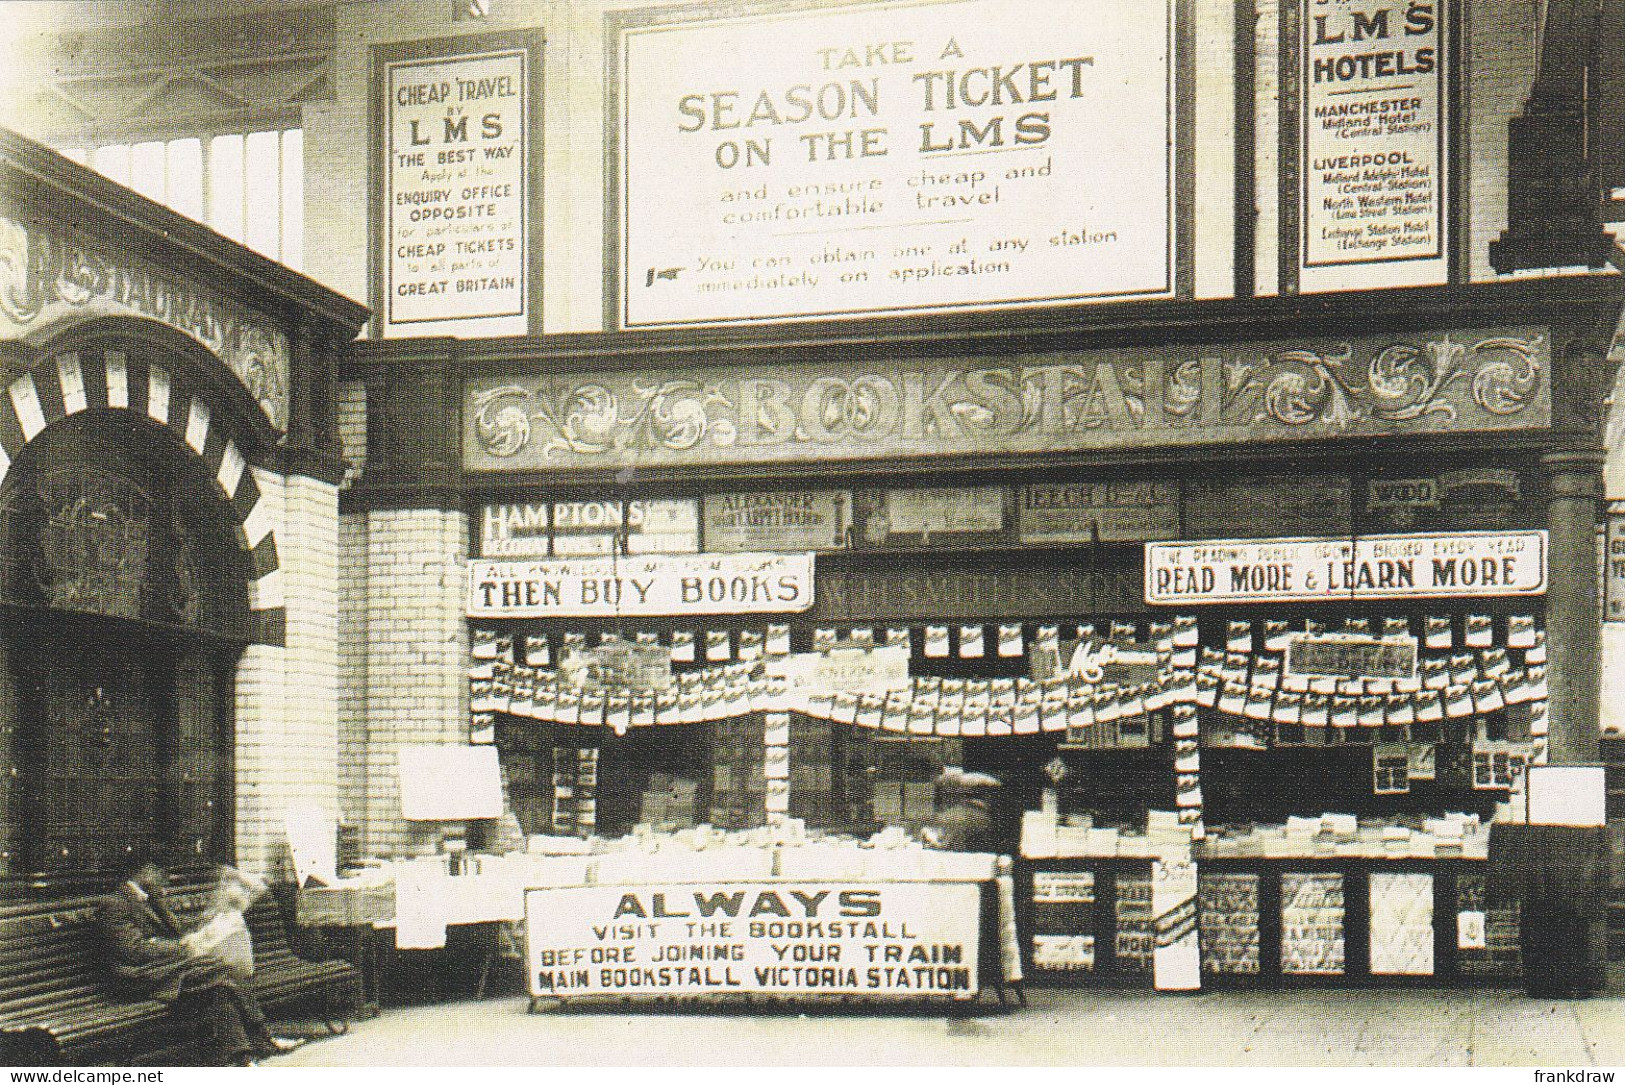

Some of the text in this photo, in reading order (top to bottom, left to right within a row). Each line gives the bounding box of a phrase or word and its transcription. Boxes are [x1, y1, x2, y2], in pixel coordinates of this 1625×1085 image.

[817, 35, 965, 71] TAKE A
[1314, 46, 1435, 83] HOTELS
[397, 76, 517, 106] CHEAP TRAVEL
[678, 56, 1095, 134] SEASON TICKET
[1314, 97, 1422, 118] MANCHESTER
[1379, 111, 1416, 125] Hotel
[715, 112, 1052, 170] ON THE LMS
[437, 149, 476, 165] BEST
[1313, 150, 1414, 171] LIVERPOOL
[397, 184, 512, 207] ENQUIRY OFFICE
[721, 157, 1054, 204] and ensure cheap and
[410, 204, 496, 223] OPPOSITE
[722, 187, 1000, 225] comfortable travel
[397, 238, 515, 259] CHEAP TICKETS
[697, 255, 735, 273] You
[752, 254, 792, 270] can
[810, 241, 875, 264] obtain
[948, 238, 968, 254] at
[989, 235, 1030, 254] any
[1048, 227, 1118, 248] station
[397, 276, 516, 297] GREAT BRITAIN
[697, 261, 1011, 295] immediately on application
[736, 357, 1250, 446] BOOKSTALL
[478, 574, 800, 607] THEN BUY BOOKS
[1156, 566, 1216, 596] READ
[1230, 563, 1293, 592] MORE
[1327, 559, 1415, 591] LEARN
[1432, 556, 1518, 587] MORE
[613, 890, 883, 920] ALWAYS
[592, 921, 918, 942] VISIT THE BOOKSTALL
[540, 944, 964, 967] BEFORE JOINING YOUR TRAIN
[538, 966, 970, 991] MAIN BOOKSTALL VICTORIA STATION
